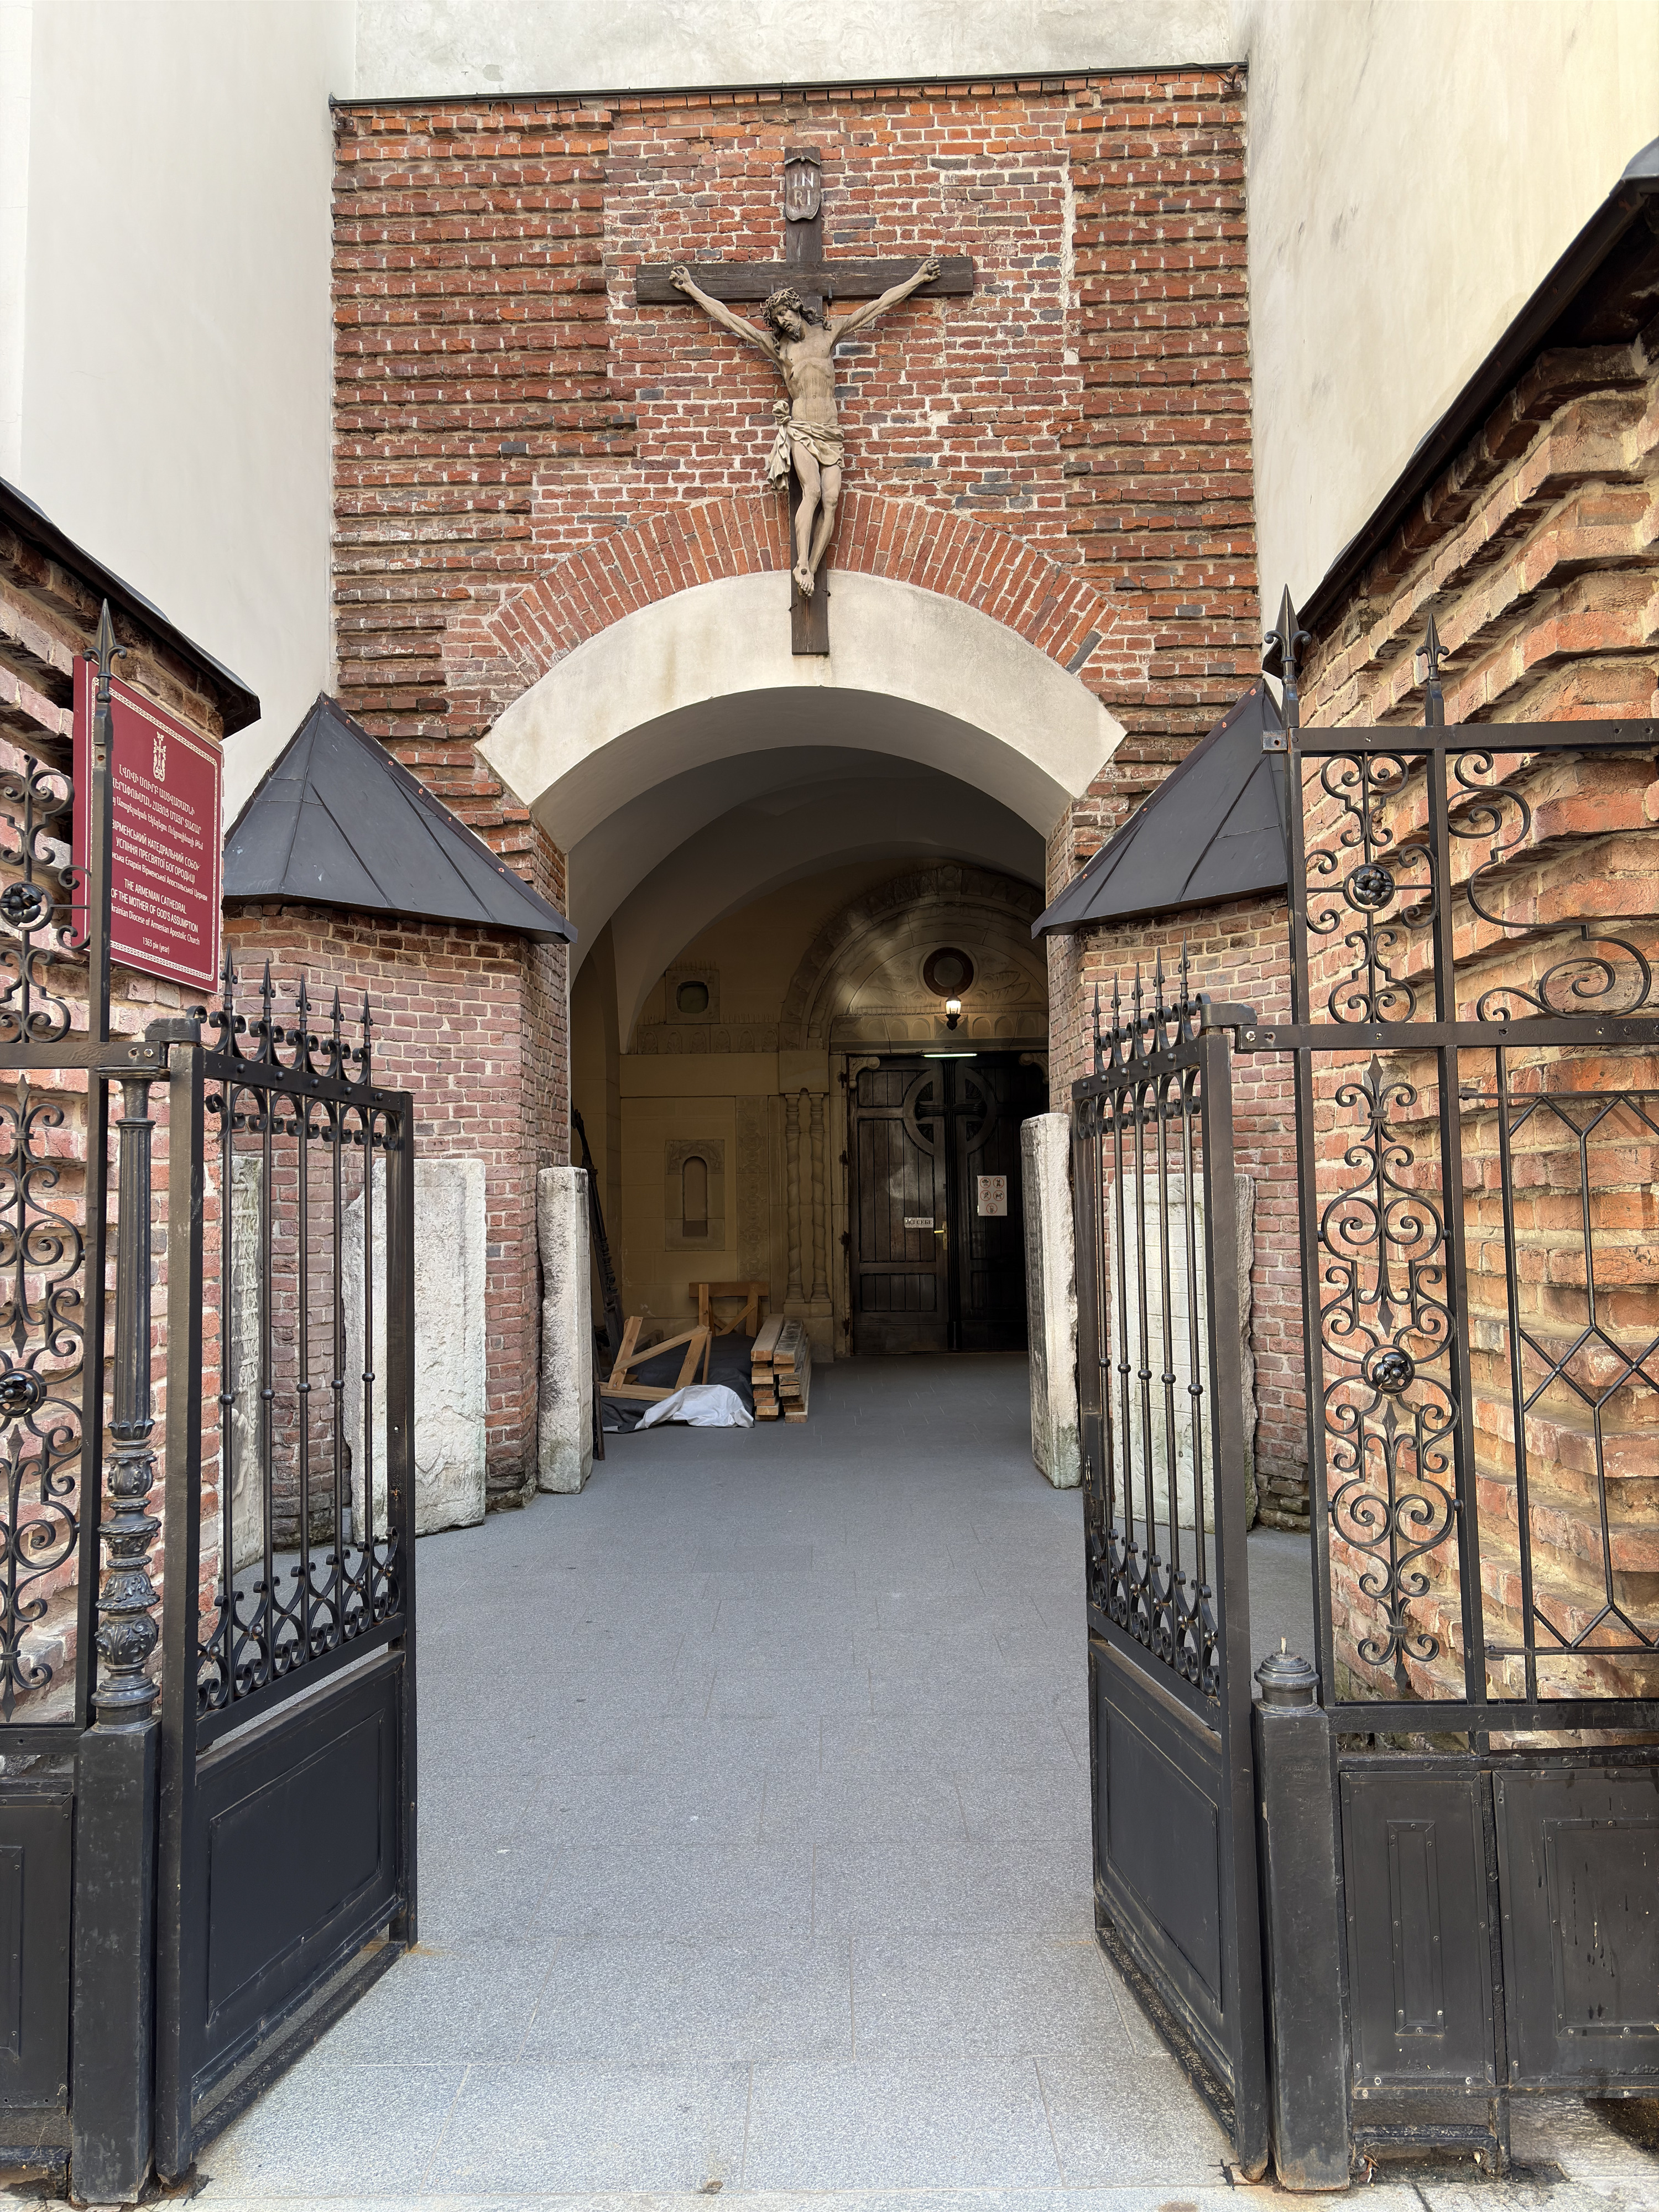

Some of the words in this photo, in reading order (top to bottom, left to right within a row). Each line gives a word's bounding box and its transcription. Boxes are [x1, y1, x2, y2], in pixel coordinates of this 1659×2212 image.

[794, 173, 813, 187] IN
[794, 190, 811, 206] RI
[119, 764, 138, 783] ԼՎՈՎԻ
[140, 776, 158, 794] ՍՈՒՐԲ
[159, 788, 195, 815] ԱՍՏՎԱԾԱԾՆԻ
[152, 801, 169, 817] ՀԱՅՈՑ
[170, 811, 184, 825] ՄԱՅՐ
[185, 817, 201, 834] ՏԱՃԱՐ
[116, 837, 138, 855] УСПІННЯ
[139, 847, 165, 868] ПРЕСВЯТОЇ
[165, 862, 195, 885] БОГОРОДИЦІ
[148, 838, 184, 864] КАТЕДРАЛЬНИЙ
[124, 879, 134, 891] THE
[135, 884, 160, 902] ARMENIAN
[161, 895, 186, 914] CATHEDRAL
[126, 857, 141, 871] Єпархія
[142, 865, 166, 882] Вірменської
[166, 877, 194, 895] Апостольської
[194, 890, 207, 901] Церкви
[111, 888, 118, 899] OF
[119, 891, 128, 903] THE
[129, 896, 149, 912] MOTHER
[150, 905, 156, 914] OF
[156, 907, 170, 921] GOD'S
[171, 915, 198, 933] ASSUMPTION
[111, 903, 128, 917] krainian
[129, 911, 144, 924] Diocese
[145, 917, 150, 926] of
[151, 920, 169, 934] Armenian
[170, 927, 186, 940] Apostolic
[187, 934, 200, 945] Church
[142, 937, 152, 947] 1363
[159, 943, 170, 954] (year)
